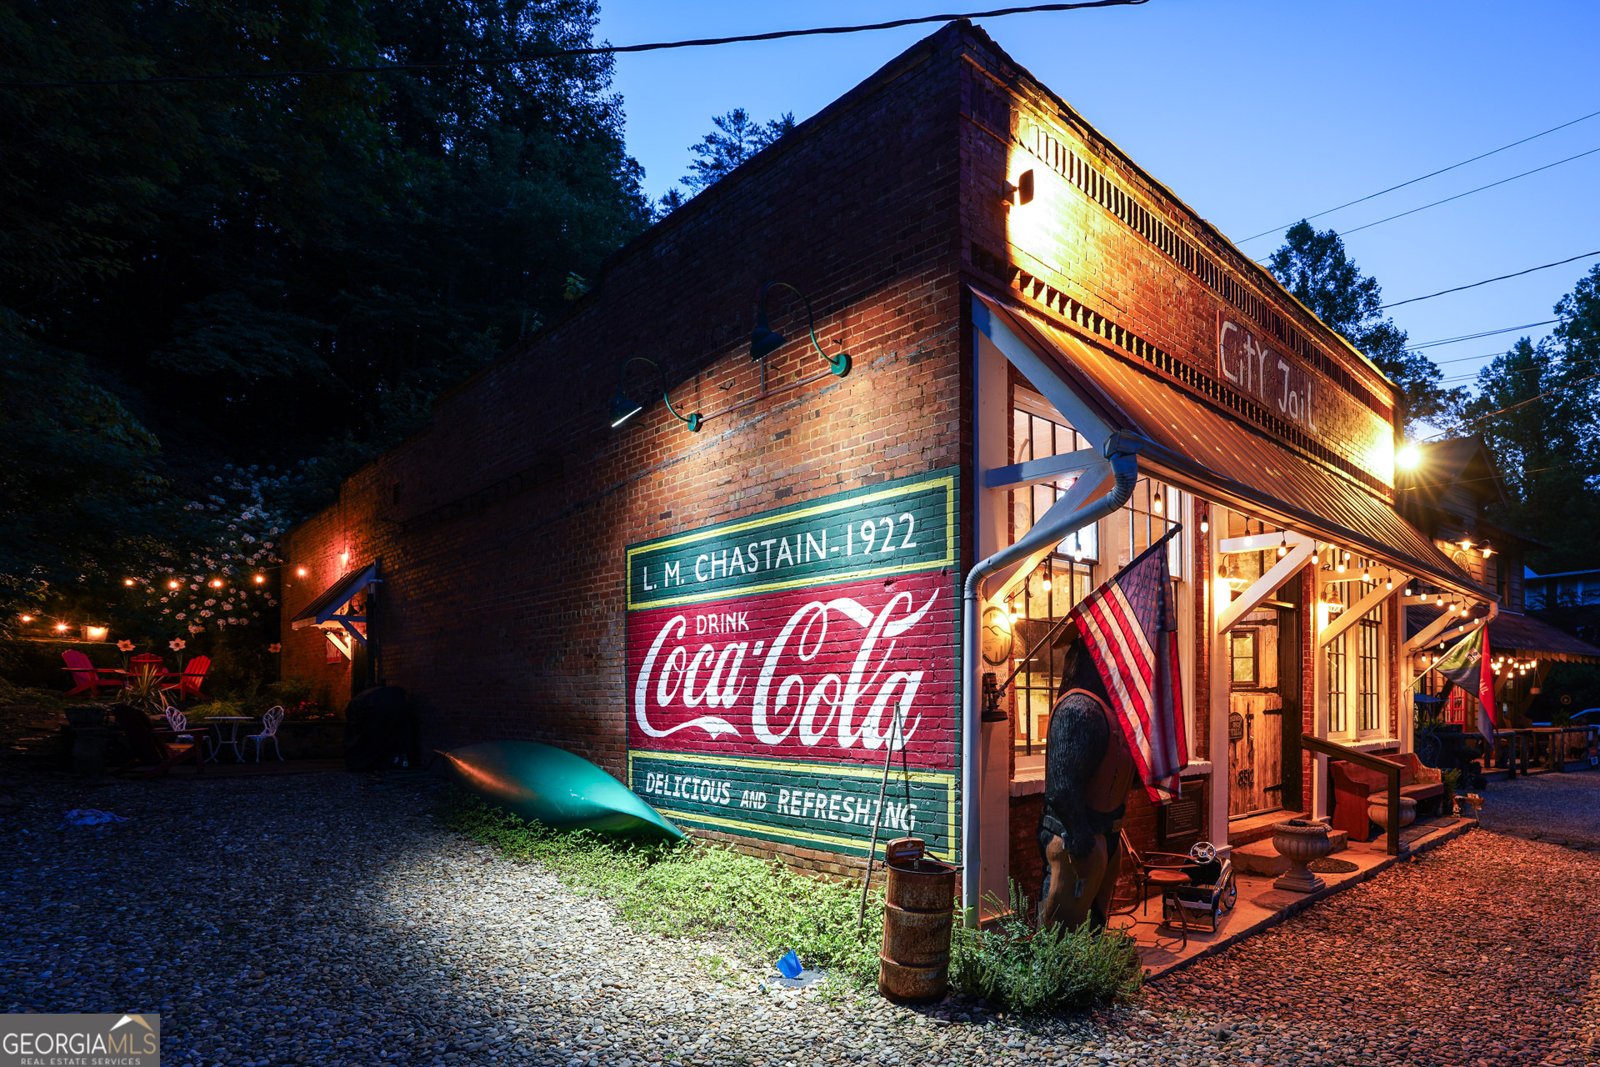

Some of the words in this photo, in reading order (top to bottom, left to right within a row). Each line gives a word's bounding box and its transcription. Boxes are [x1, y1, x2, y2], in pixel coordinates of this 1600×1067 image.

[643, 565, 658, 591] L.
[664, 560, 685, 587] M.
[696, 611, 750, 635] DRINK
[635, 588, 940, 751] Coca-Cola
[645, 772, 731, 805] DELICIOUS
[740, 789, 767, 809] AND
[777, 788, 917, 831] REFRESHING
